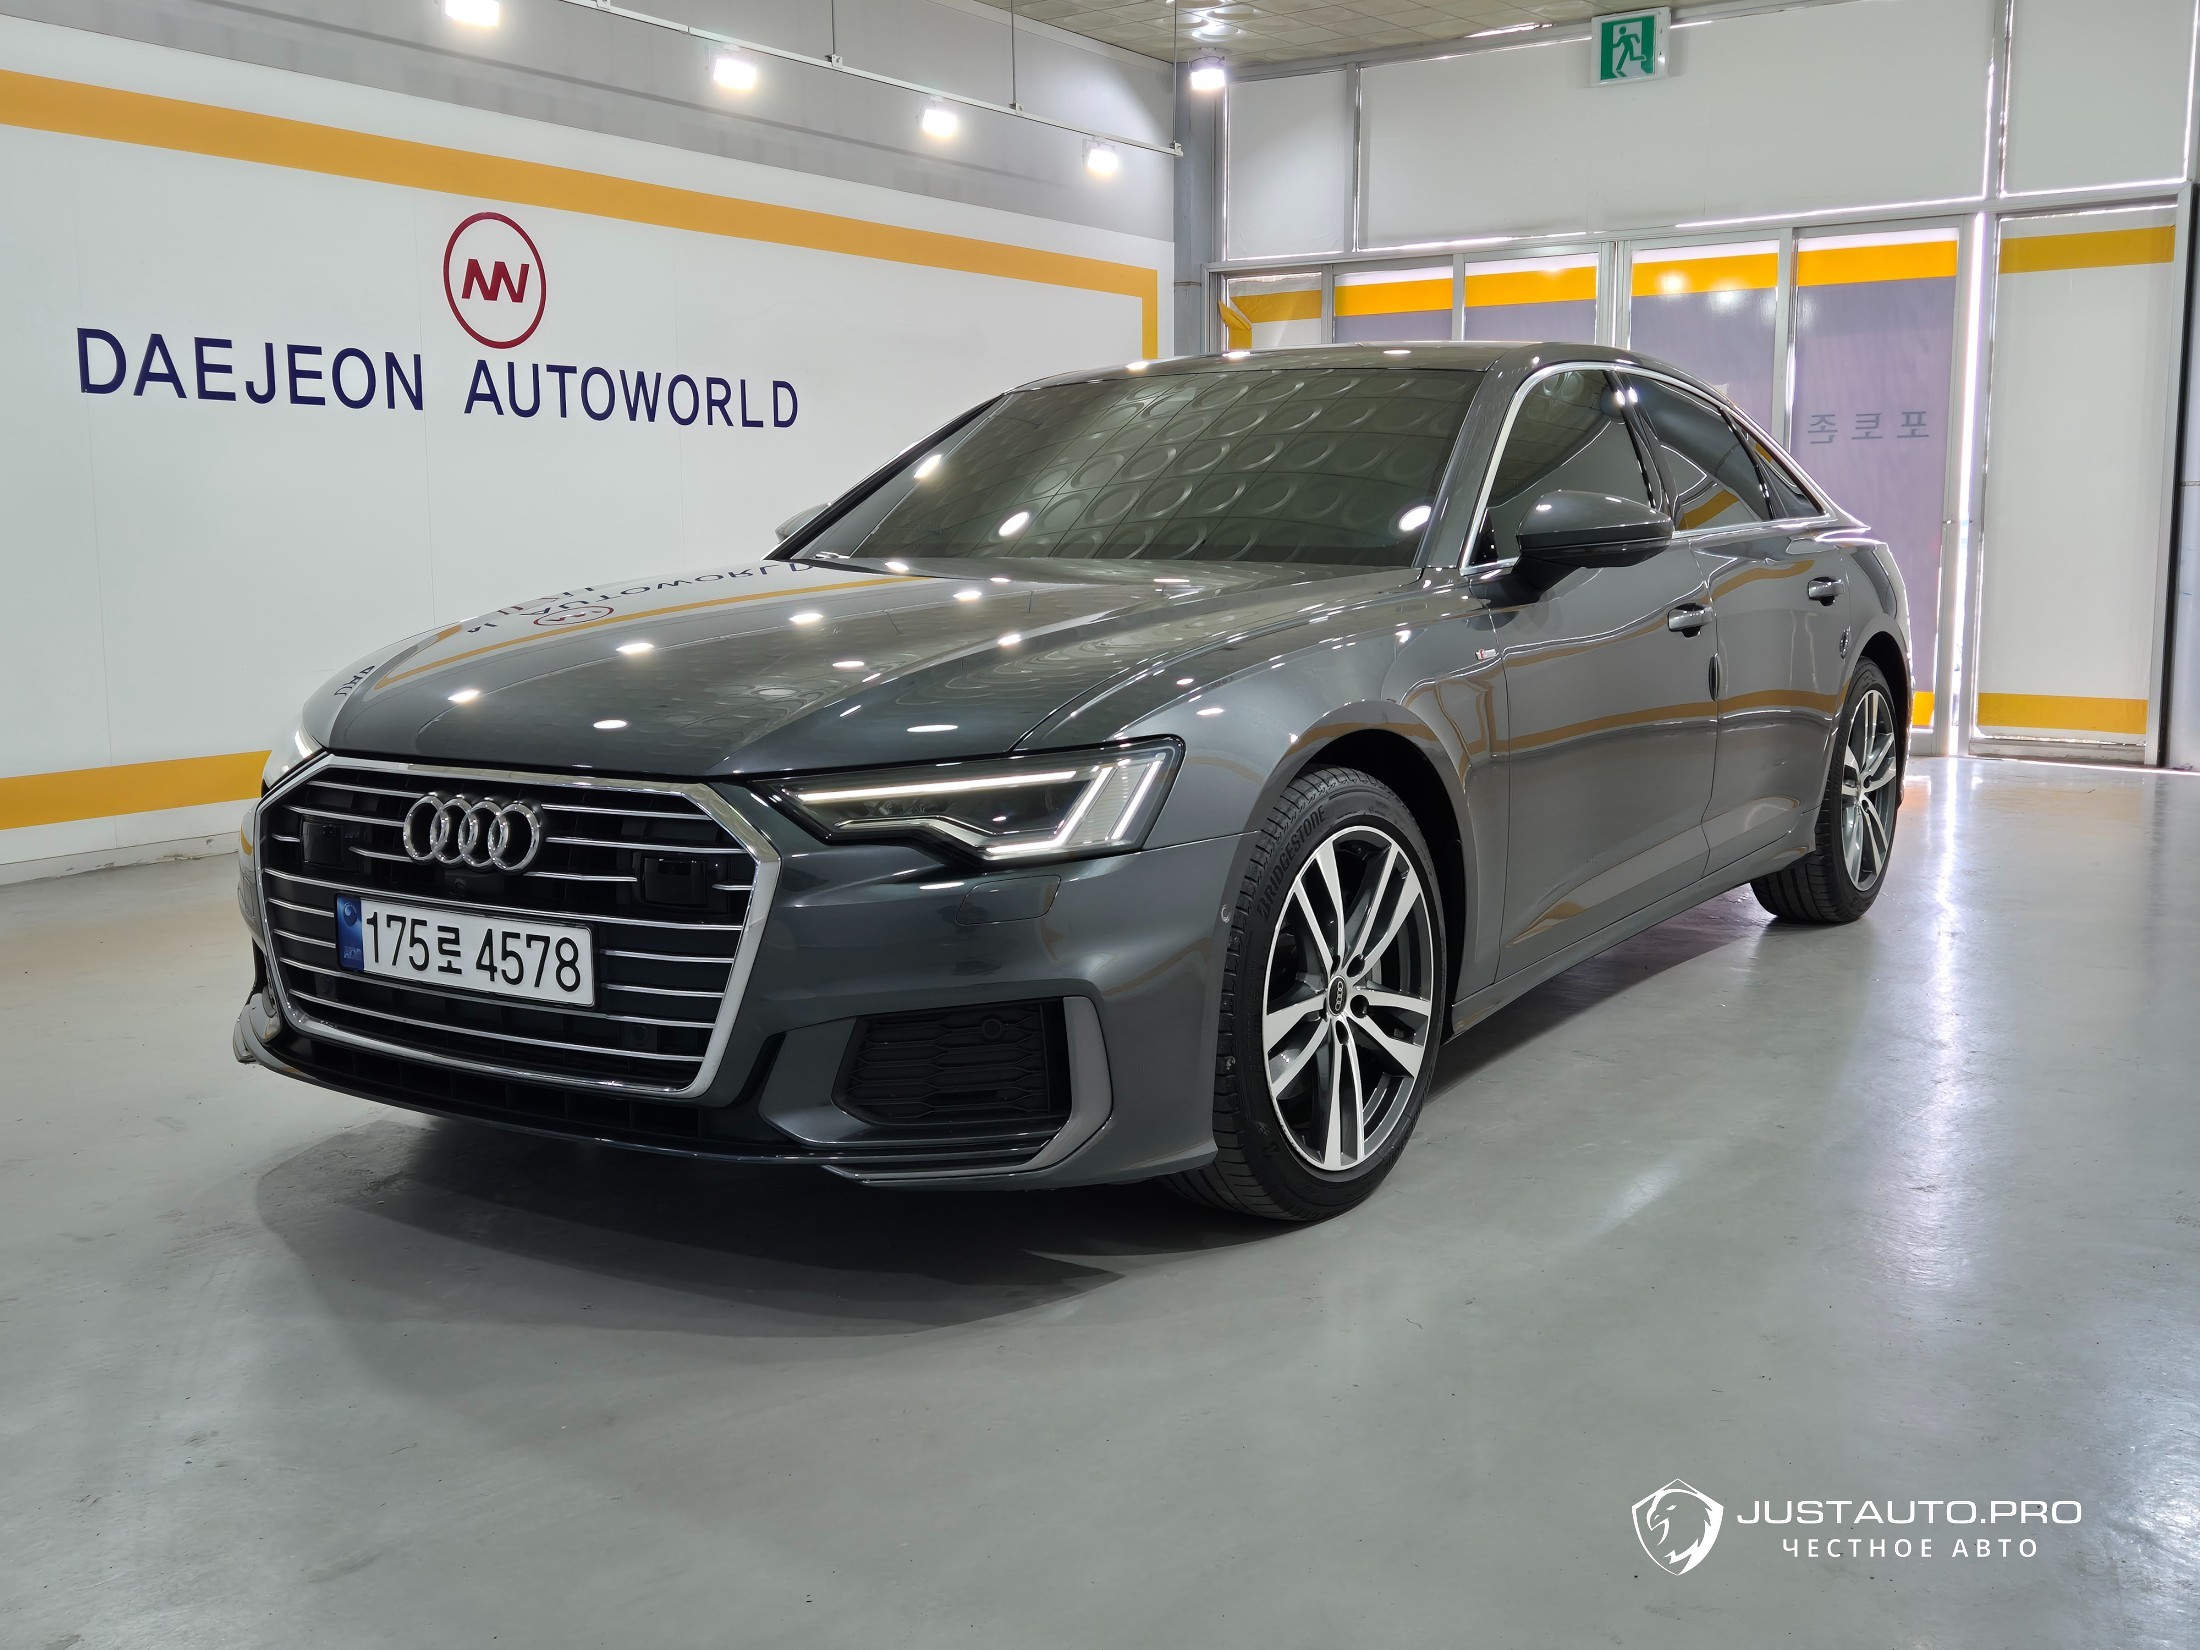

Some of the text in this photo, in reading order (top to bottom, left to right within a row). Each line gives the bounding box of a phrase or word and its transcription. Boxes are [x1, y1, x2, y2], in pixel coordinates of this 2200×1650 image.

[77, 328, 798, 428] DAEJEON AUTOWORLD
[1256, 804, 1329, 921] BRIDGESTONE
[366, 911, 581, 992] 175로 4578
